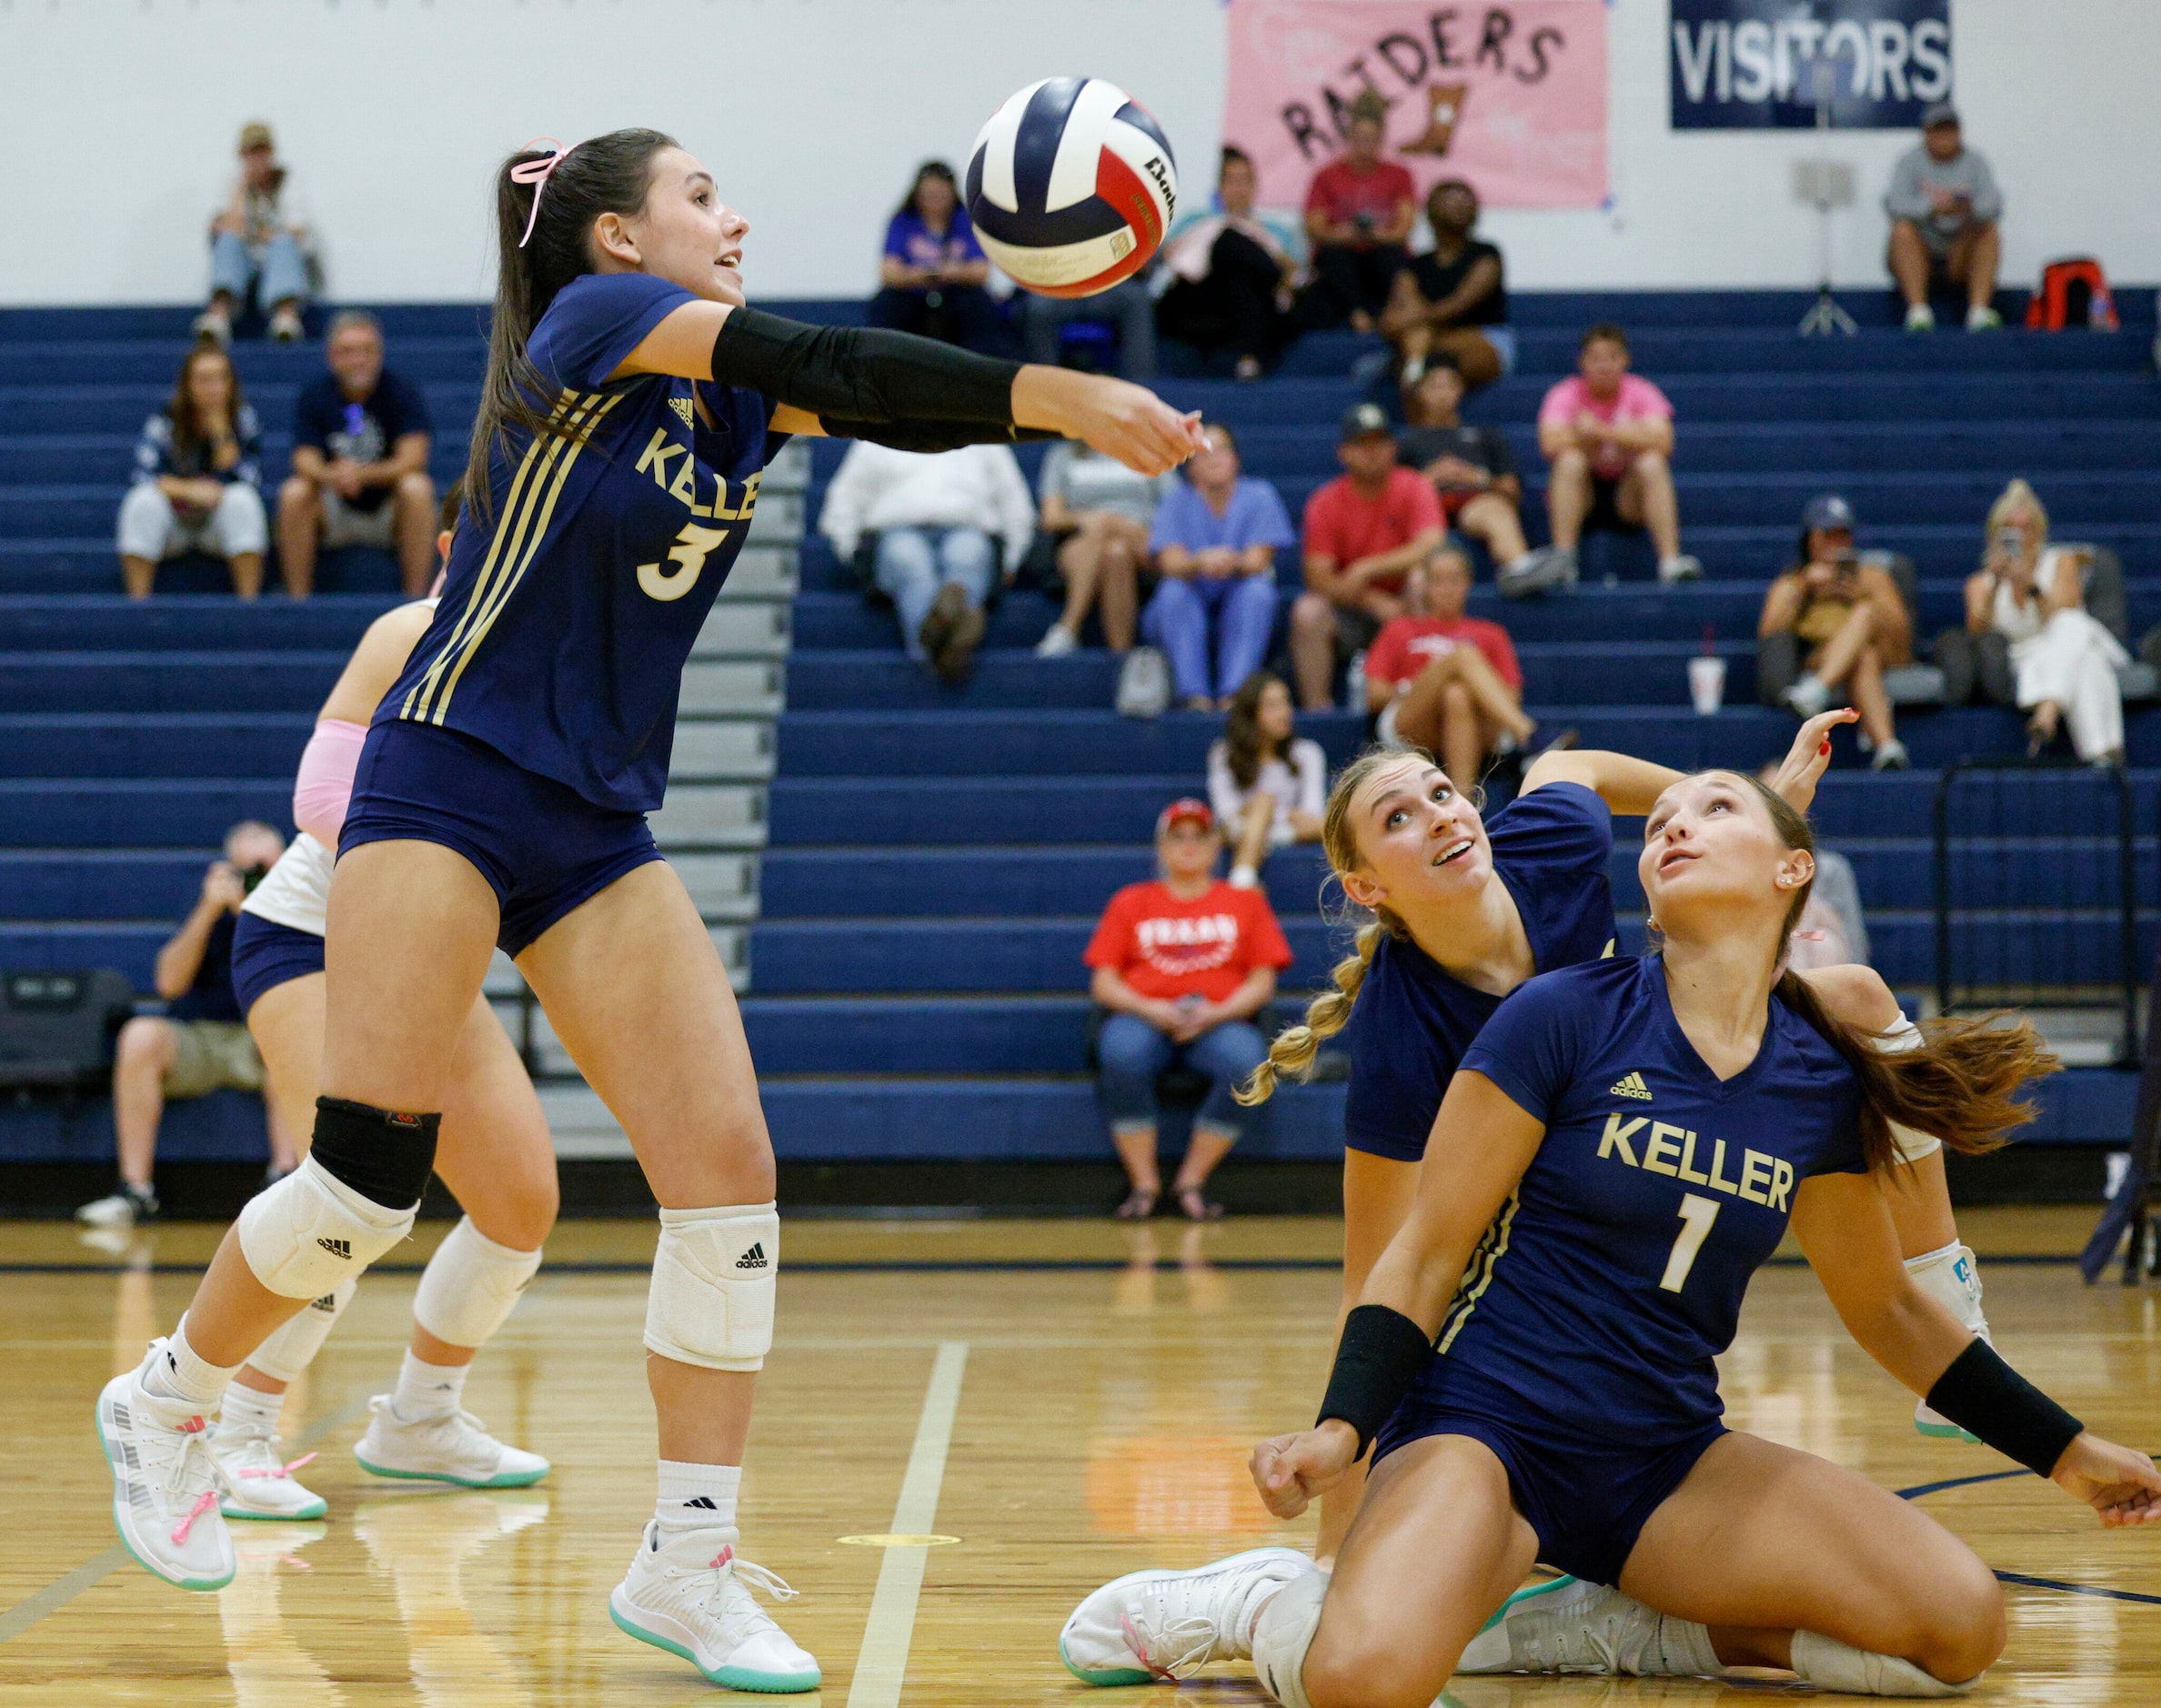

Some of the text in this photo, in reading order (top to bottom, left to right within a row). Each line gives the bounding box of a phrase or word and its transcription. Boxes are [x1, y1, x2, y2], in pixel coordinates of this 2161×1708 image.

[1674, 18, 1949, 104] VISITORS
[637, 521, 730, 602] 3
[1610, 1085, 1653, 1100] adidas
[1596, 1111, 1794, 1214] KELLER
[1659, 1192, 1722, 1294] 1
